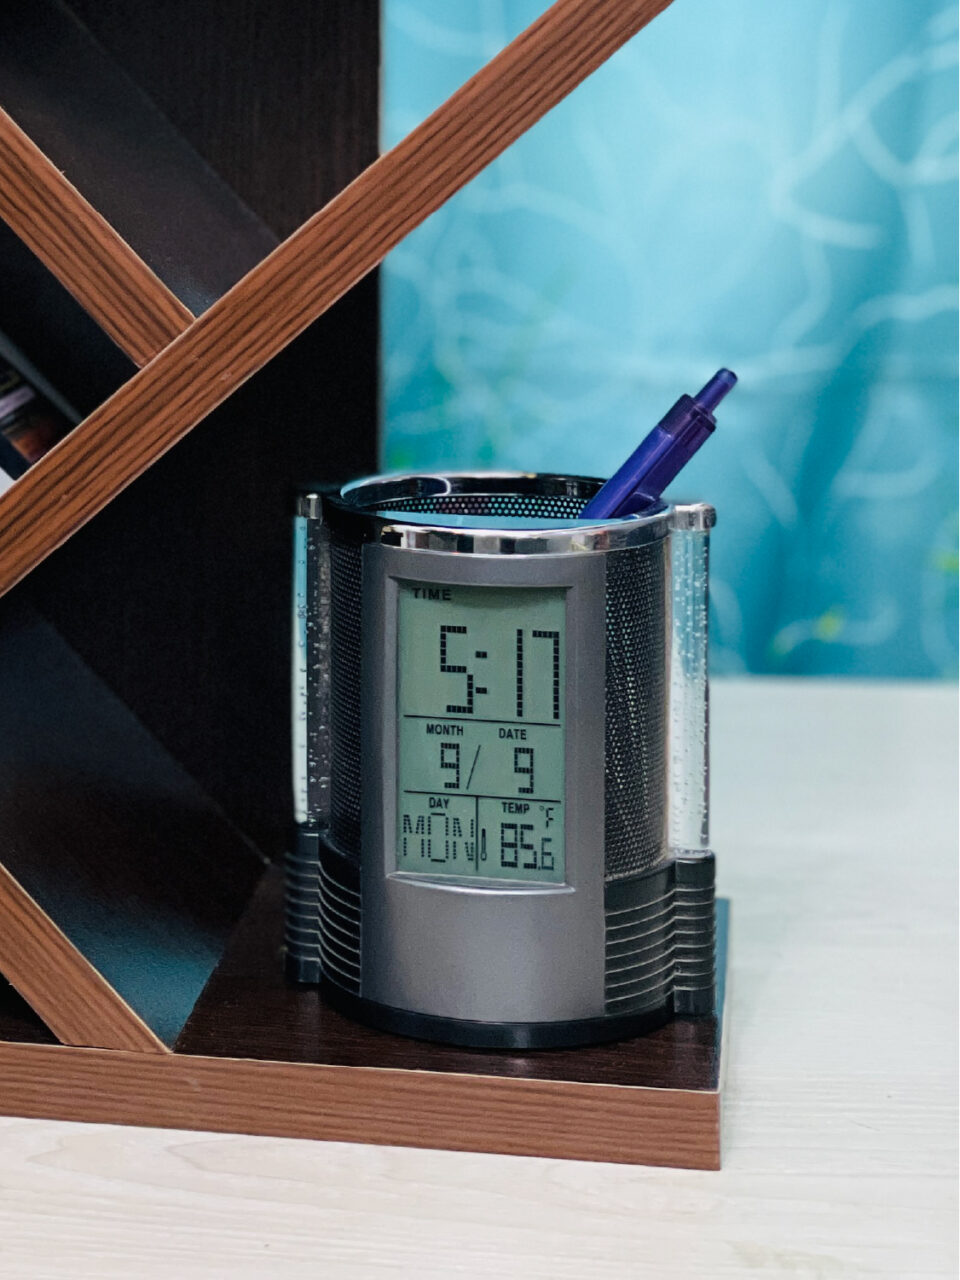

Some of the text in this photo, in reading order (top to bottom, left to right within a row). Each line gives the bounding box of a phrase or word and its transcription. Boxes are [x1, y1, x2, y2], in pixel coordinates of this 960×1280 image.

[413, 587, 452, 601] TIME
[440, 625, 559, 719] 5:17
[426, 723, 464, 736] MONTH
[499, 728, 527, 740] DATE
[429, 797, 450, 809] DAY
[501, 802, 530, 814] TEMP
[403, 812, 474, 863] MON
